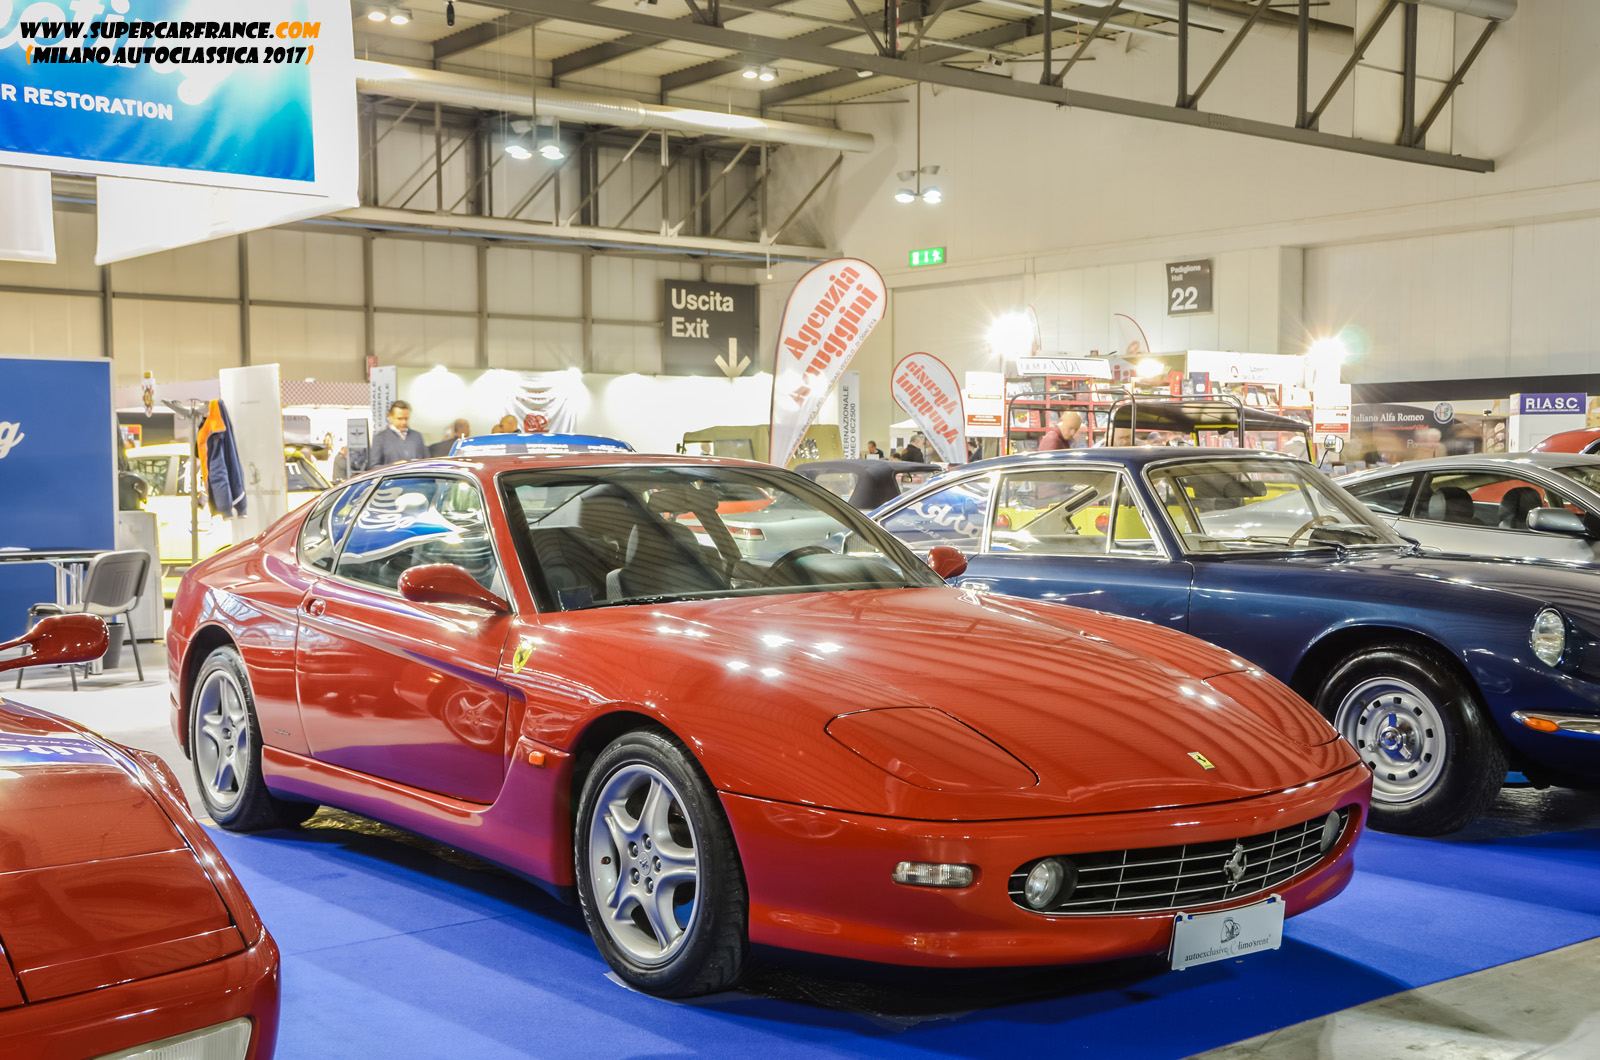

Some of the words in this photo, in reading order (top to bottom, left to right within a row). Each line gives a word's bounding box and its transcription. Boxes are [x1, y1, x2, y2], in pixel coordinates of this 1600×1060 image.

[23, 86, 174, 121] RESTORATION
[1170, 265, 1202, 274] Padiglione
[1171, 274, 1184, 282] Hall
[671, 288, 734, 312] Uscita
[1171, 286, 1198, 311] 22
[783, 266, 861, 361] Agenzia
[671, 316, 709, 339] Exit
[1525, 397, 1580, 409] R.I.A.S.C.
[1380, 413, 1396, 422] Alfa
[1397, 413, 1425, 422] Romeo
